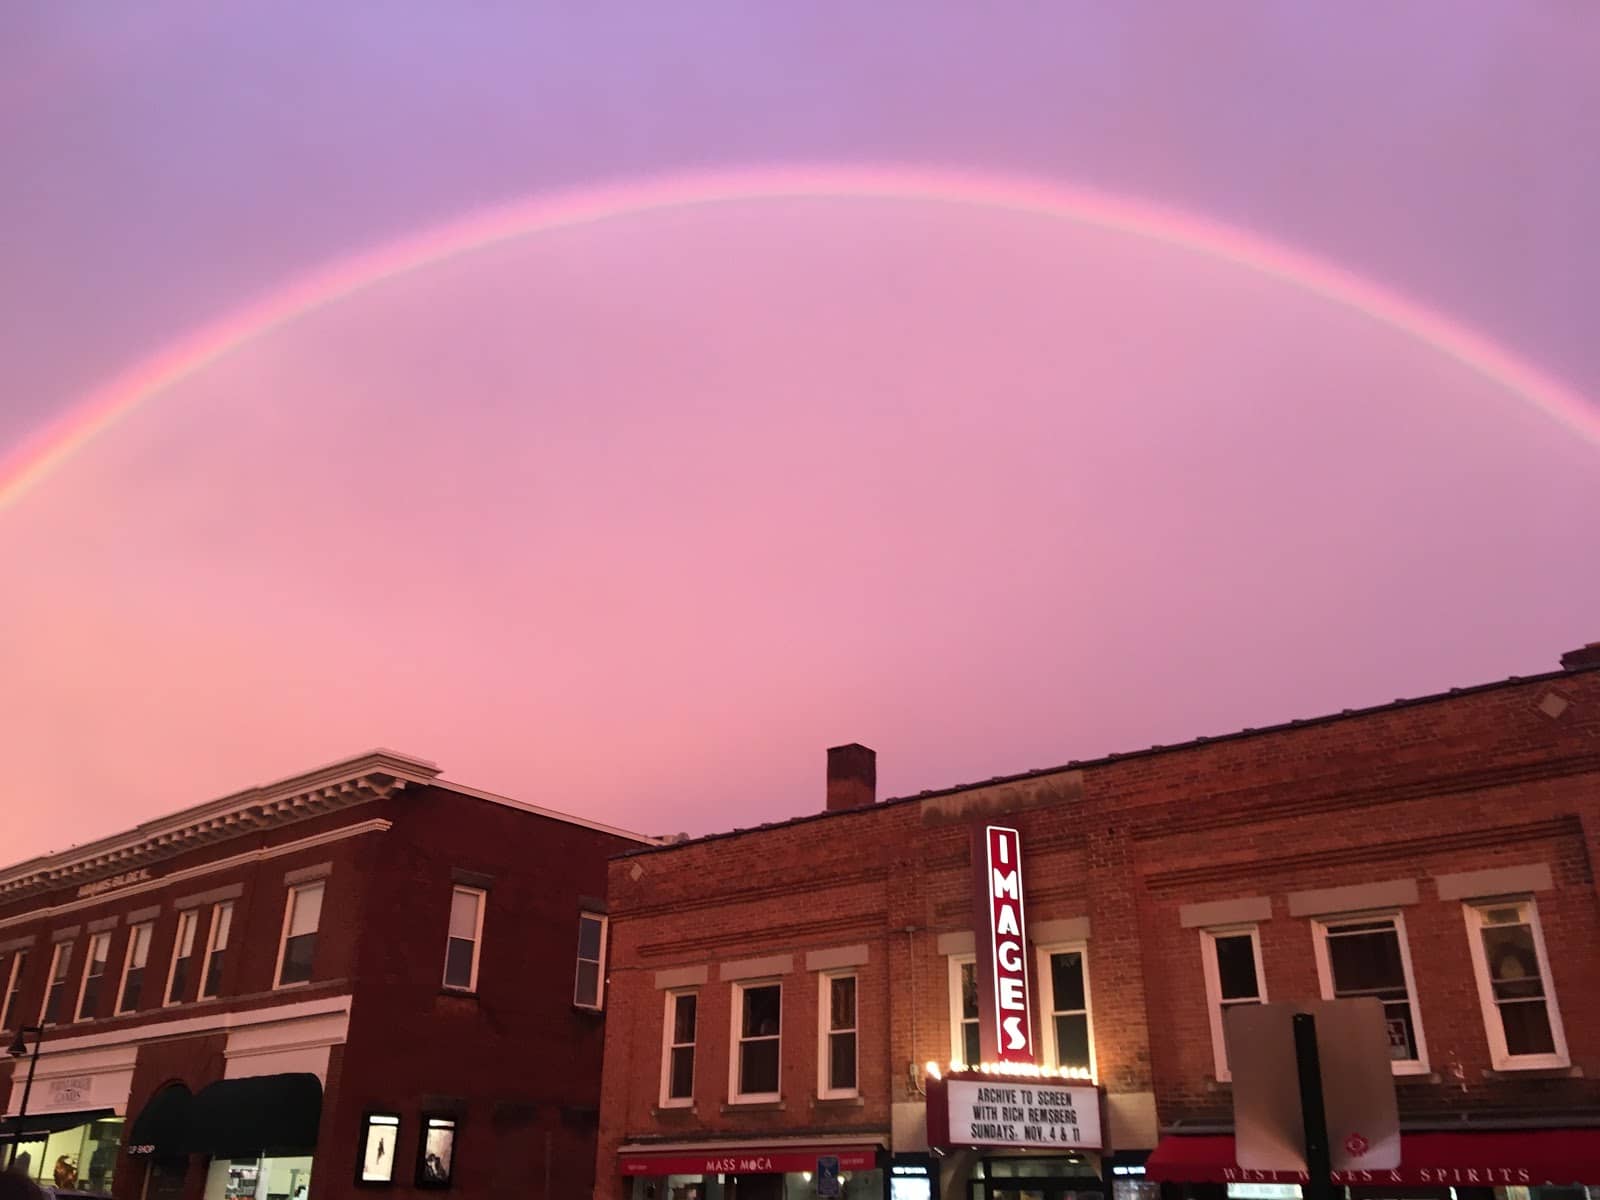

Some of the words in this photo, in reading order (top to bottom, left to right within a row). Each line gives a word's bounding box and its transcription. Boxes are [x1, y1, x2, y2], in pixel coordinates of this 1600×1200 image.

[994, 833, 1026, 1050] IMAGES
[978, 1088, 1016, 1104] ARCHIVE
[1020, 1090, 1033, 1105] TO
[1038, 1091, 1072, 1107] SCREEN
[973, 1106, 998, 1121] WITH
[1002, 1107, 1024, 1122] RICH
[1028, 1108, 1077, 1124] REMSBERG
[1049, 1126, 1056, 1141] 4
[1061, 1127, 1067, 1142] &
[1073, 1128, 1080, 1142] 11
[706, 1159, 736, 1171] MASS
[1298, 1168, 1372, 1181] WNES
[1420, 1168, 1530, 1182] SPIRITS
